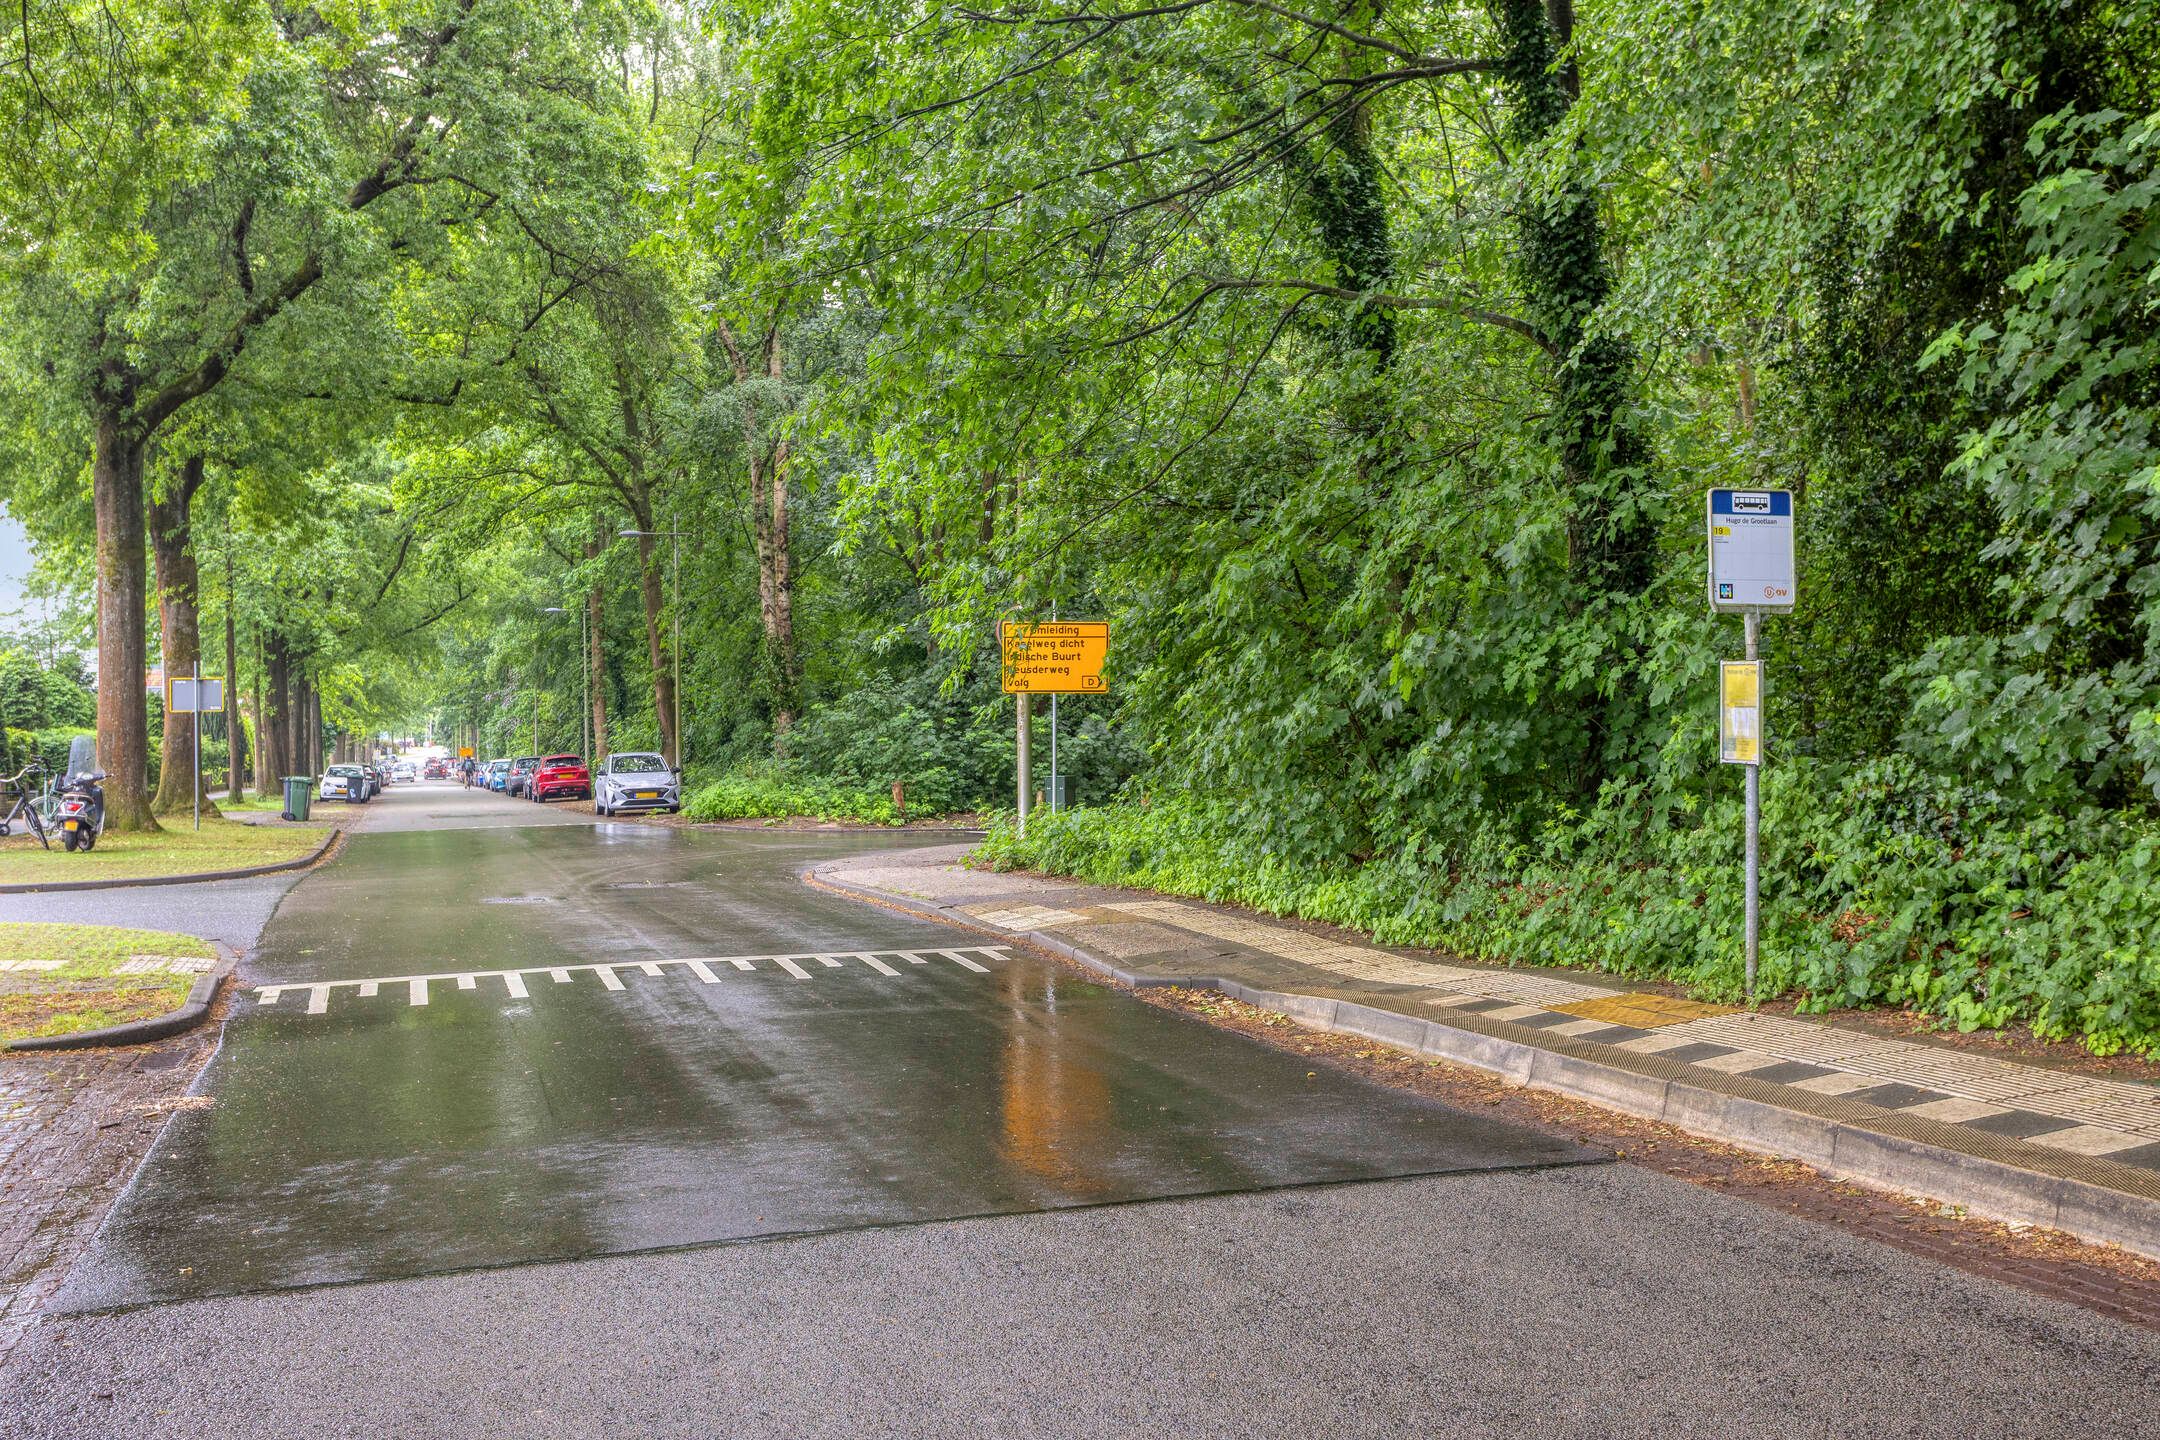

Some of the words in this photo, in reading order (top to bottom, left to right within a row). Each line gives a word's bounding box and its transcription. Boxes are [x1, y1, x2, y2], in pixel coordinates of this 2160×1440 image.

[1033, 626, 1079, 636] mleiding
[1060, 639, 1085, 648] dicht
[1007, 653, 1048, 661] Idische
[1052, 652, 1081, 661] Buurt
[1013, 666, 1070, 676] eusderweg
[1088, 678, 1095, 686] D
